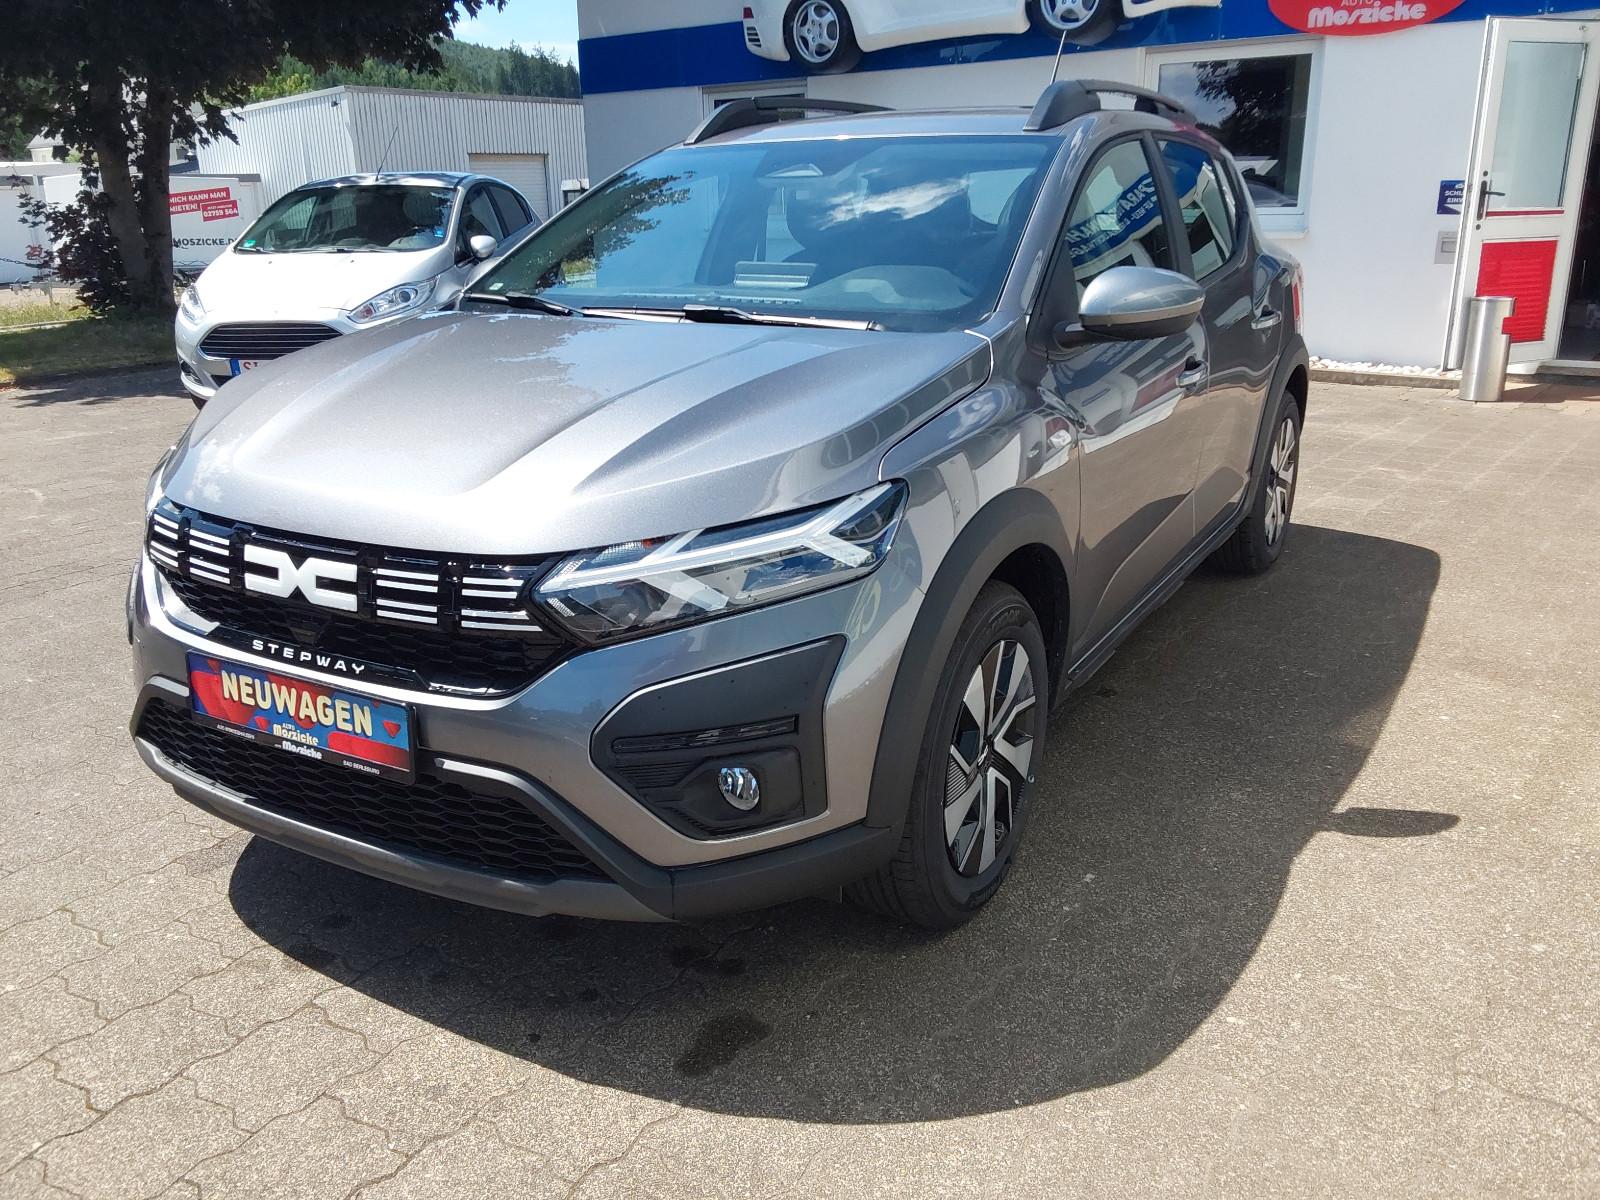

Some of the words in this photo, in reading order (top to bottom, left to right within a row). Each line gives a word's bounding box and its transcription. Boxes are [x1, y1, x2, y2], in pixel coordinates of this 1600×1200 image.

[1307, 1, 1427, 29] Moszicke
[188, 193, 209, 201] KANN
[252, 639, 365, 674] STEPWAY
[221, 670, 373, 736] NEUWAGEN
[272, 723, 319, 746] Moszicke
